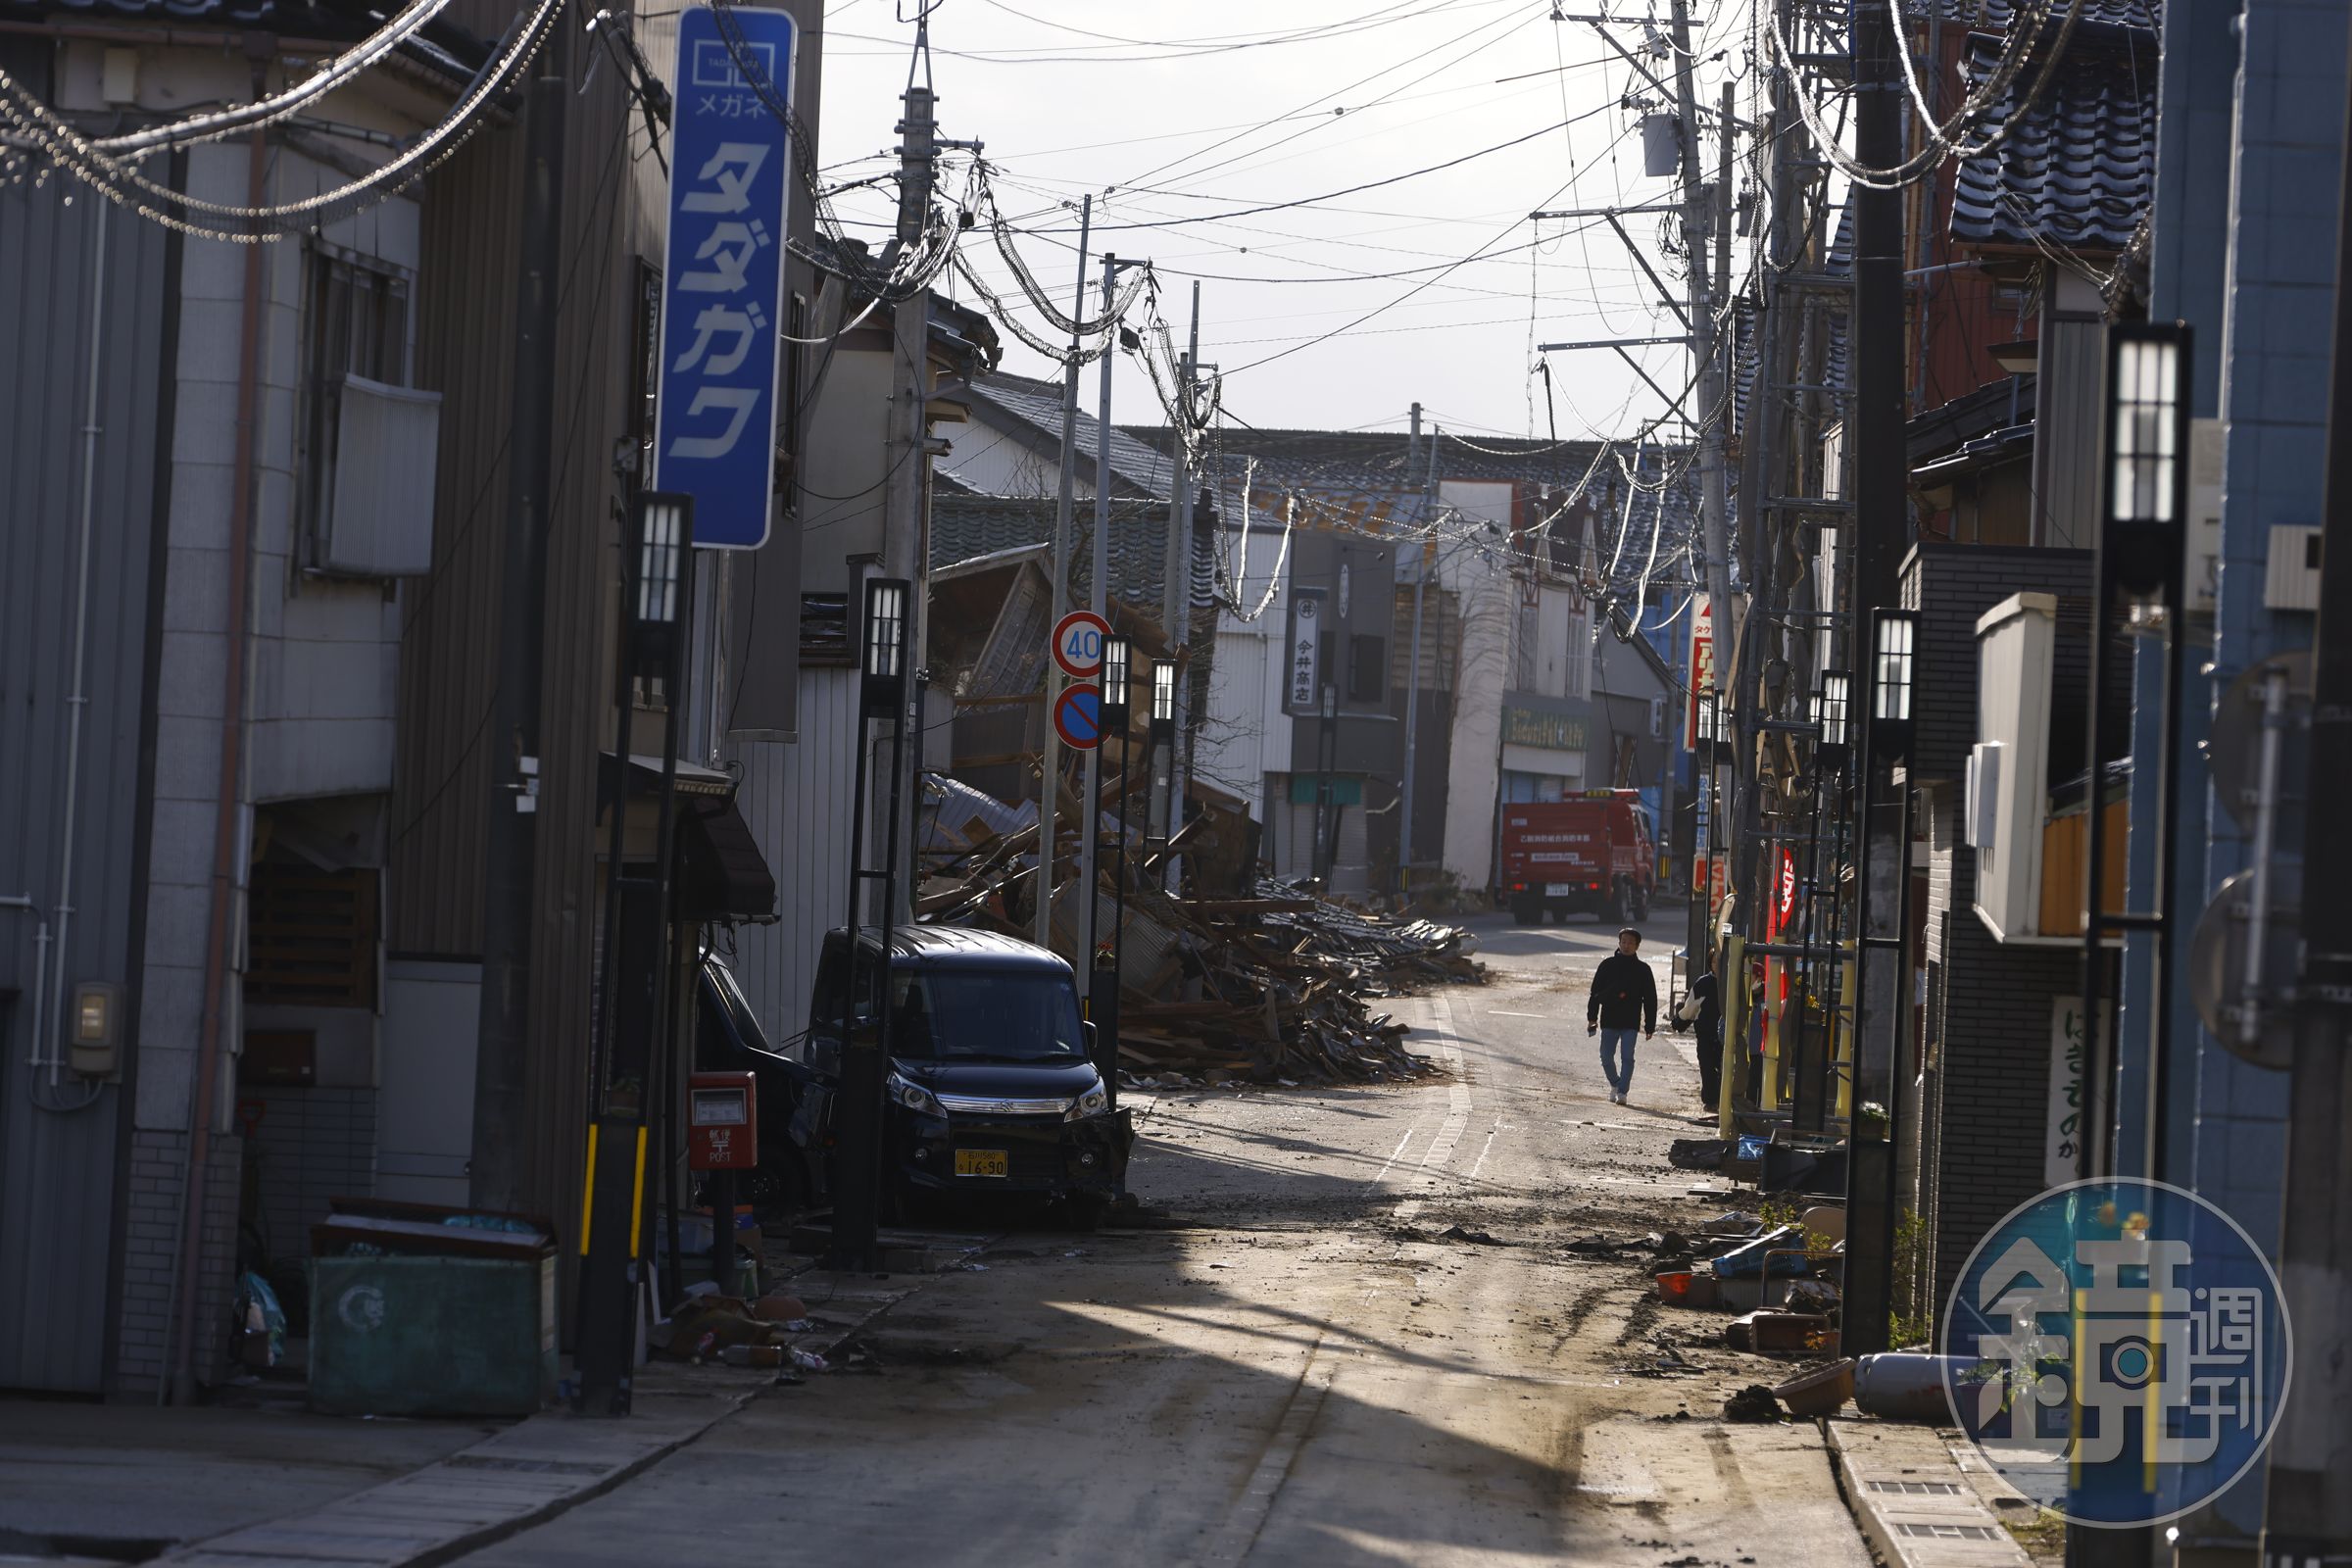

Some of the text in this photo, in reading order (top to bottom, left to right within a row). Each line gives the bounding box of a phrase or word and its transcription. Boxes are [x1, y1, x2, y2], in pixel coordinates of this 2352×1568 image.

[696, 93, 767, 119] メガネ
[668, 142, 771, 459] タダガワ
[1066, 630, 1102, 660] 40
[1296, 639, 1313, 702] 今井商店
[709, 1152, 731, 1162] POST
